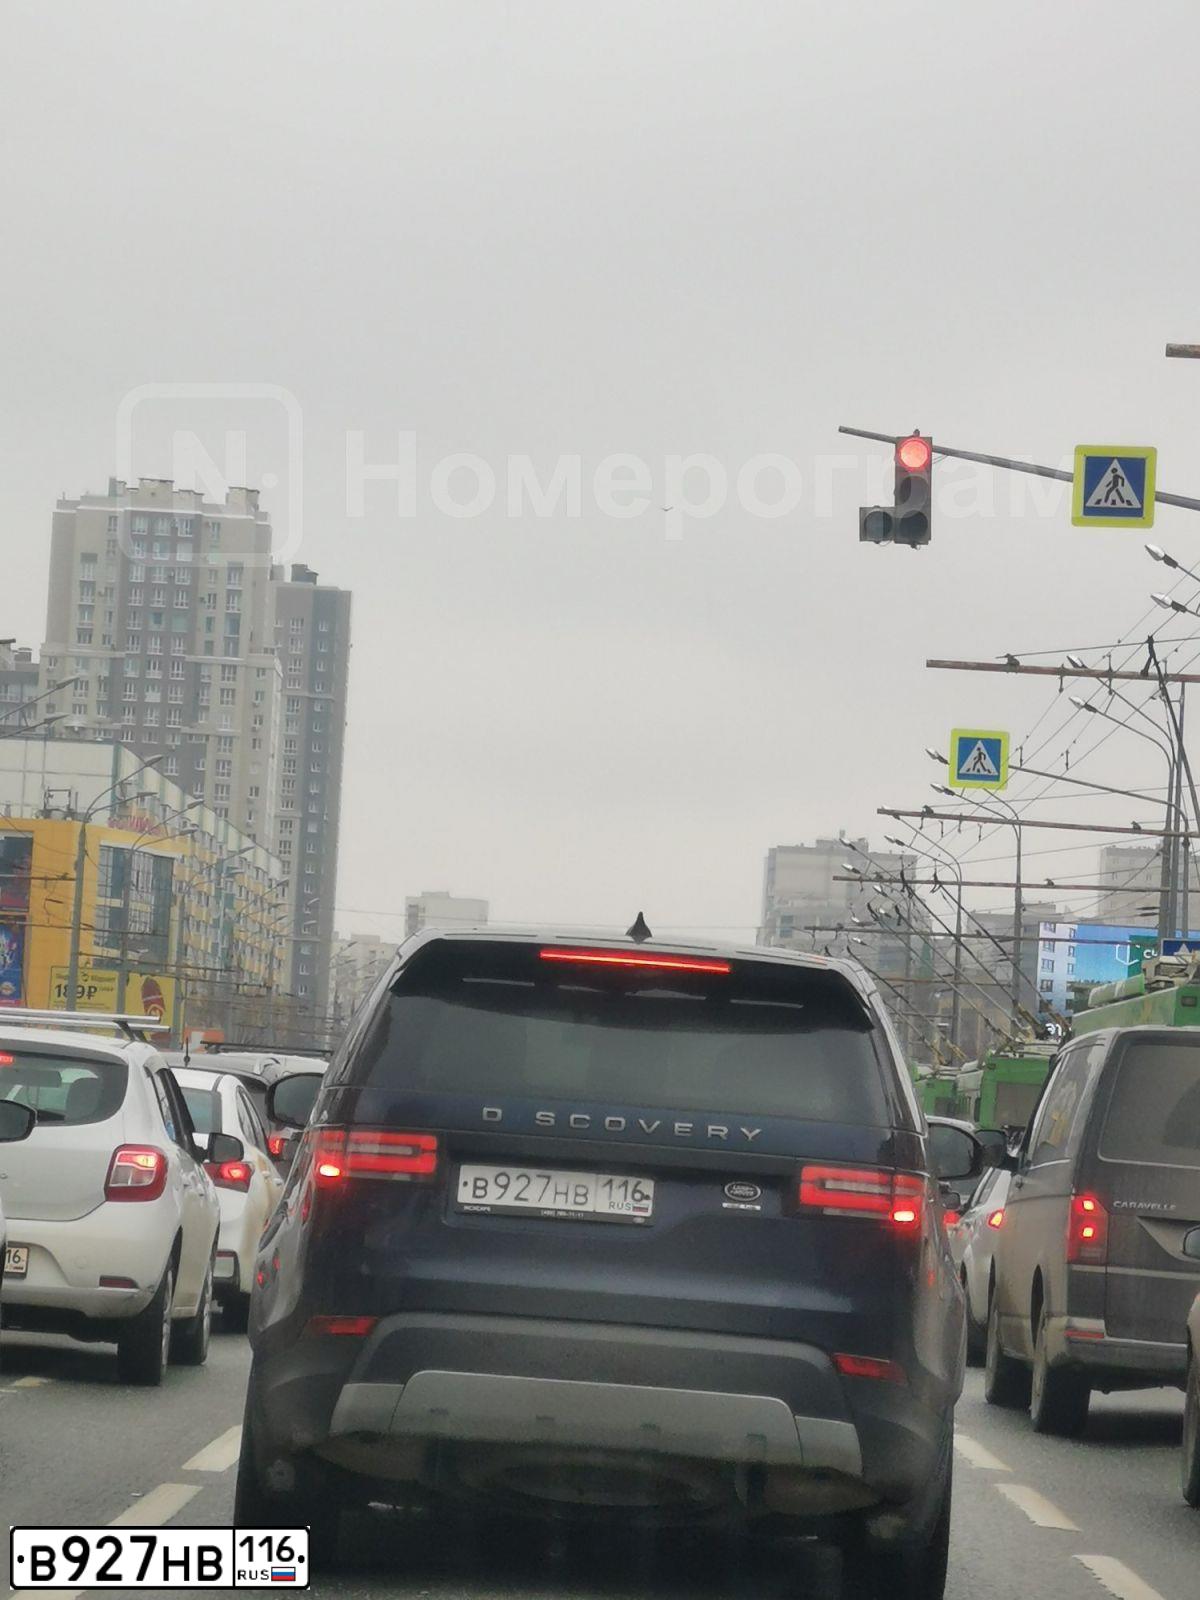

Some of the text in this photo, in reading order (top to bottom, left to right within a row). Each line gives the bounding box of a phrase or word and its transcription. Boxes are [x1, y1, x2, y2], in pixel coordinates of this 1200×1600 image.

[482, 1106, 762, 1142] DSCOVERY
[602, 1178, 645, 1203] 116
[608, 1201, 632, 1211] RUS
[1113, 1200, 1177, 1211] CARAVELLE
